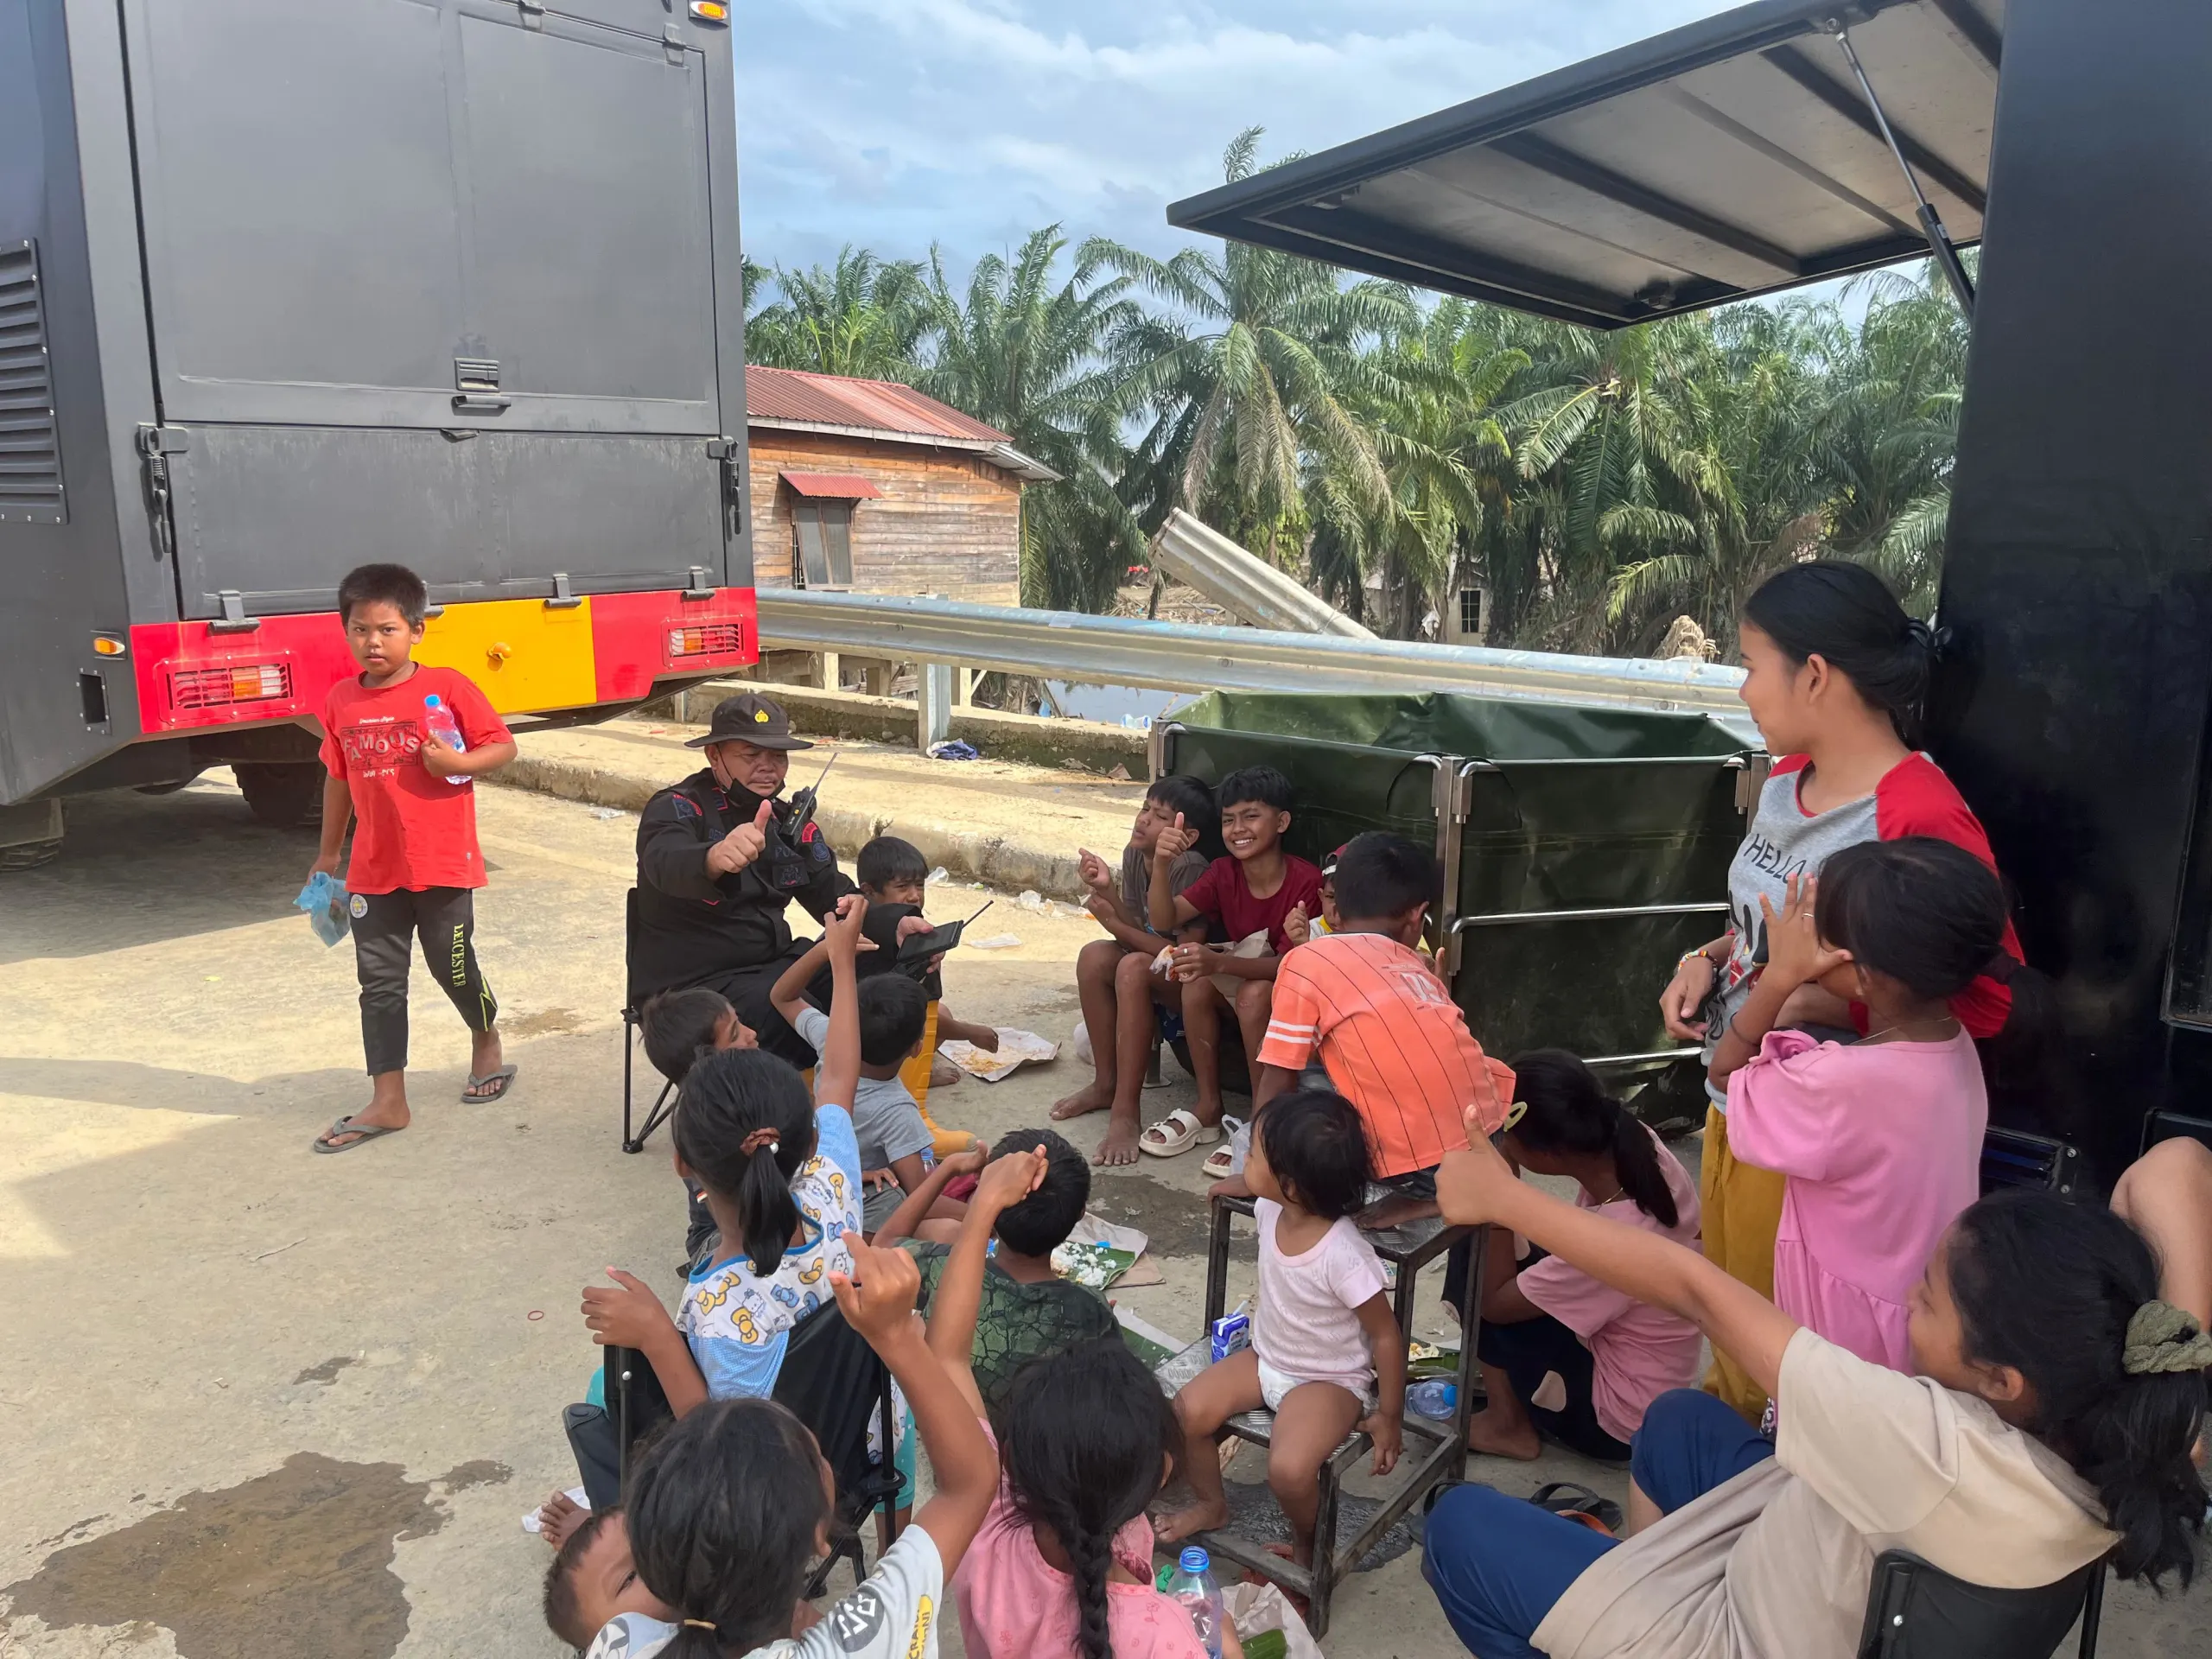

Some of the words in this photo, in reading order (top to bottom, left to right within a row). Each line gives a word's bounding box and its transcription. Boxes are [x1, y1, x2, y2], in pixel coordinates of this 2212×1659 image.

[344, 732, 422, 761] FAMOUS
[1743, 833, 1807, 884] HELLO
[451, 923, 467, 988] LEICESTER
